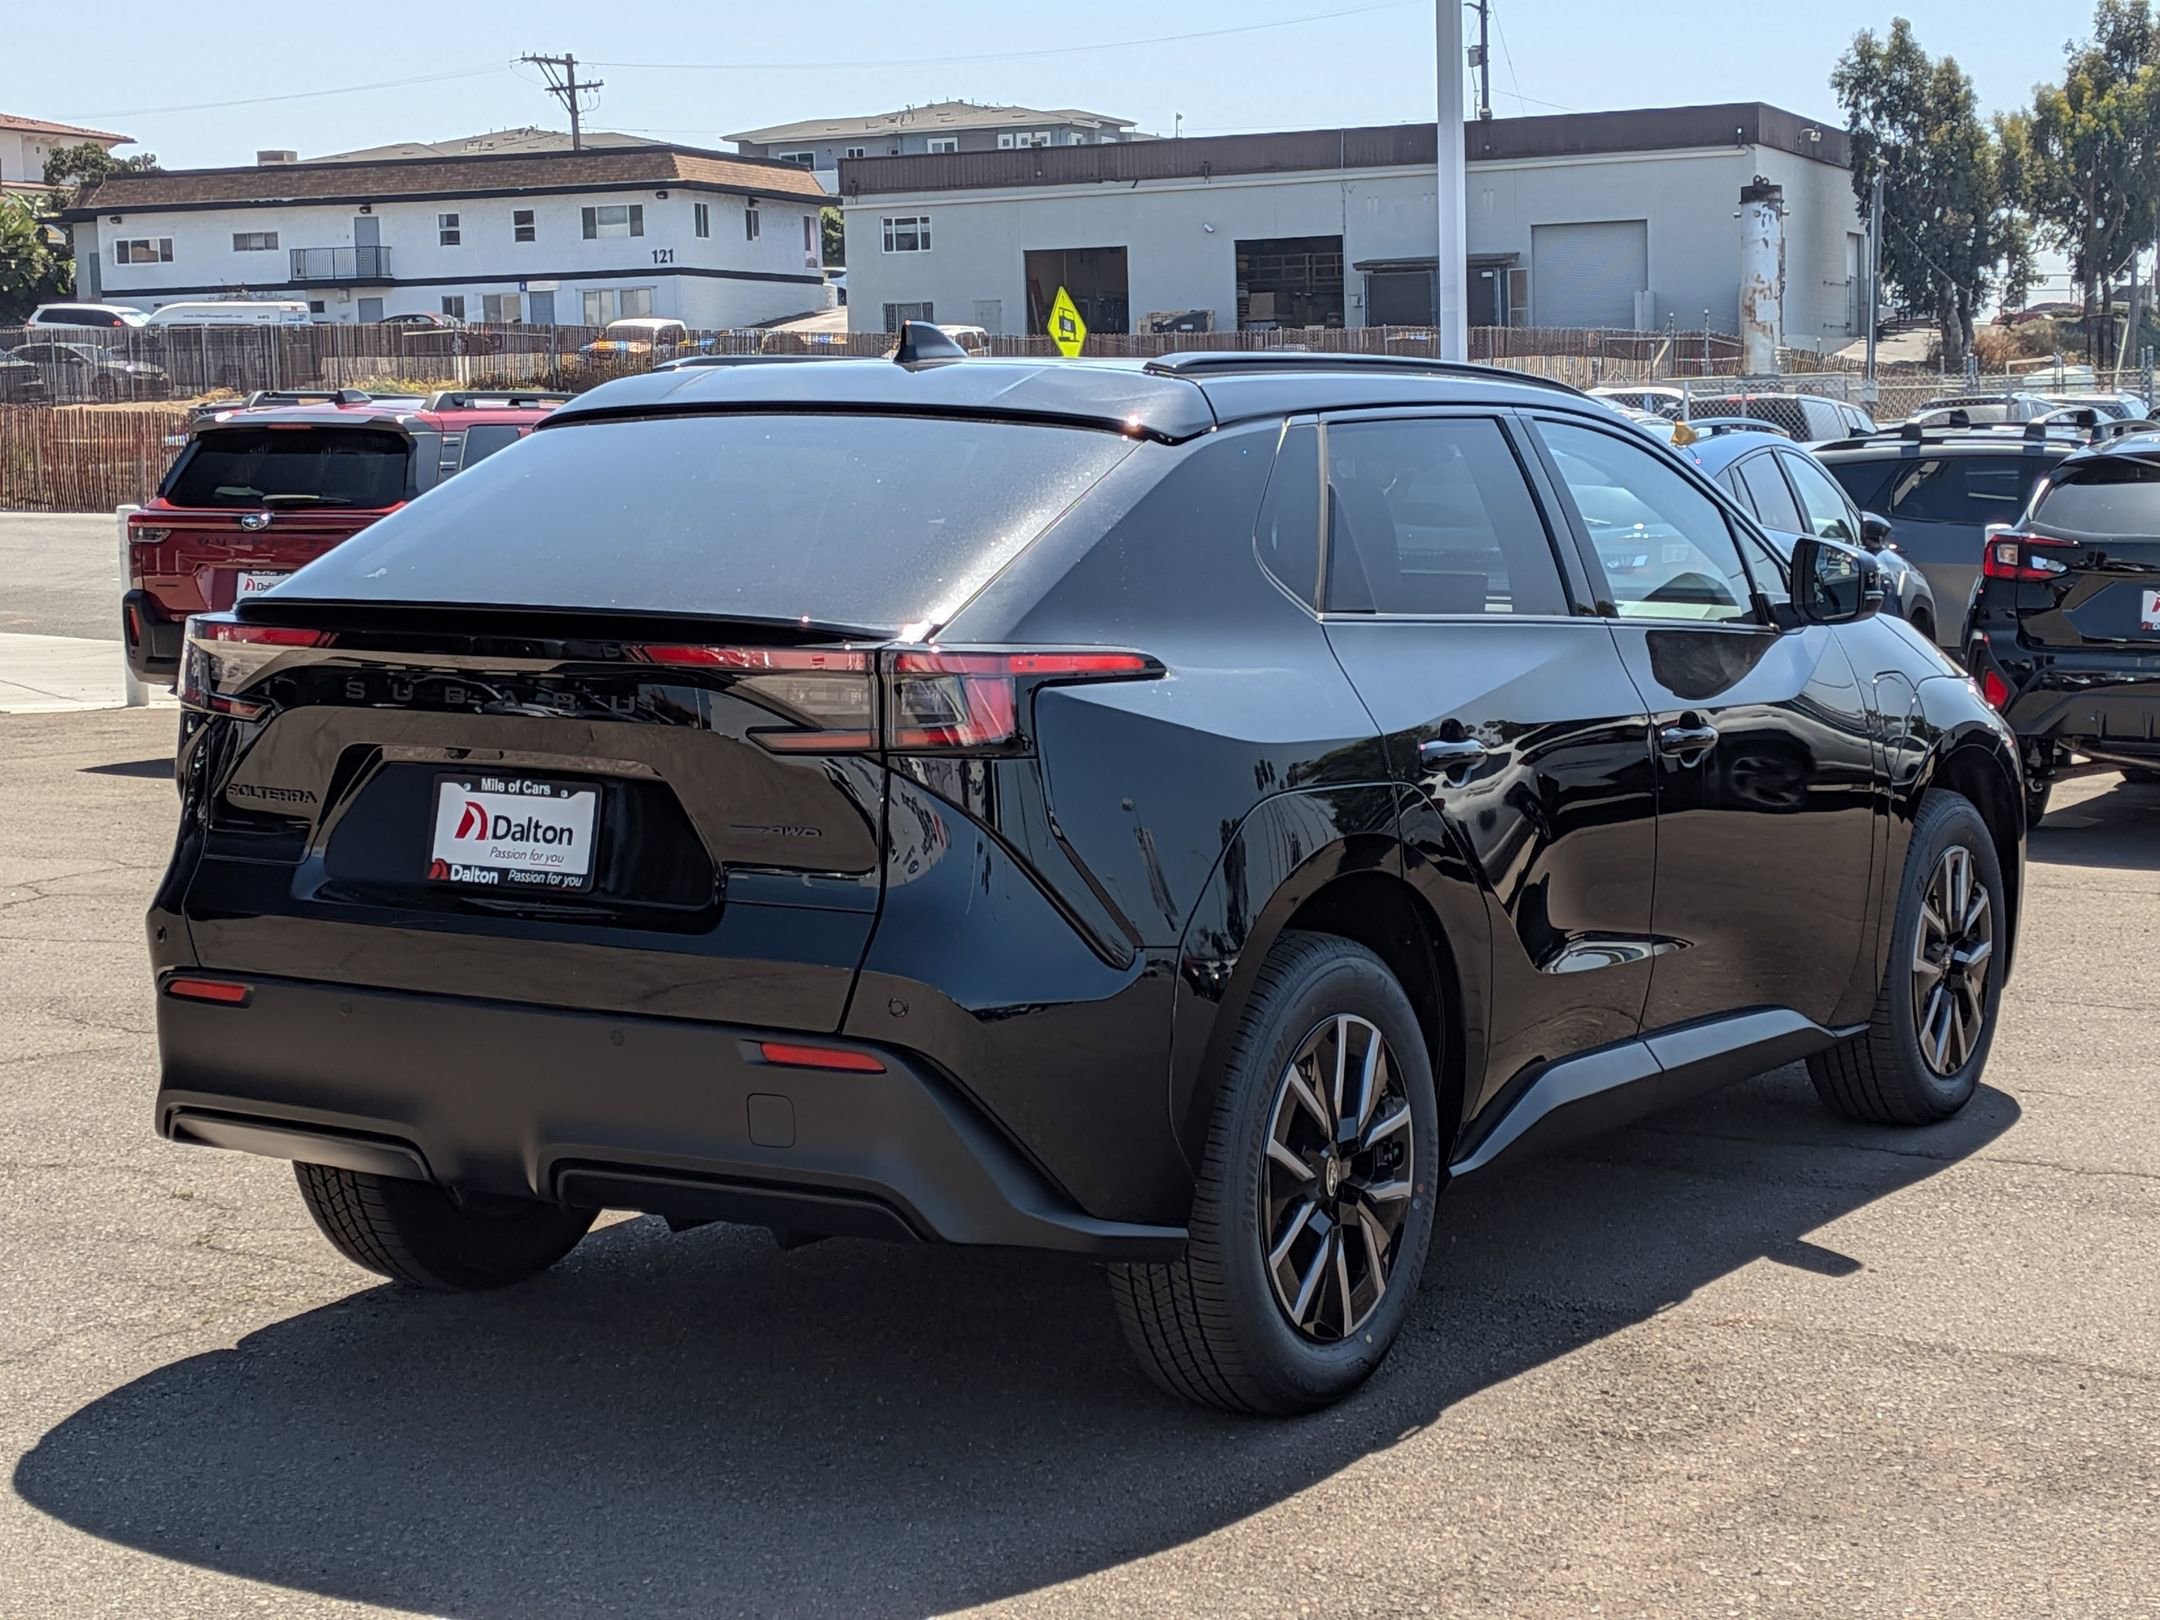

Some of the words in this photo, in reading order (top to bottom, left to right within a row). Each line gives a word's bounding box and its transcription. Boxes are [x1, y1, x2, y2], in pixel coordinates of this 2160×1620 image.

[652, 248, 674, 264] 121
[345, 680, 636, 714] SUBARU
[228, 784, 317, 804] SOLTERRA
[481, 778, 505, 792] Mile
[508, 780, 521, 793] of
[523, 782, 551, 795] Cars
[491, 814, 574, 846] Dalton
[489, 846, 531, 861] Passion
[529, 848, 544, 862] for
[545, 853, 565, 865] you
[451, 864, 498, 885] Dalton
[507, 869, 546, 884] Passion
[546, 872, 562, 885] for
[562, 875, 583, 888] you
